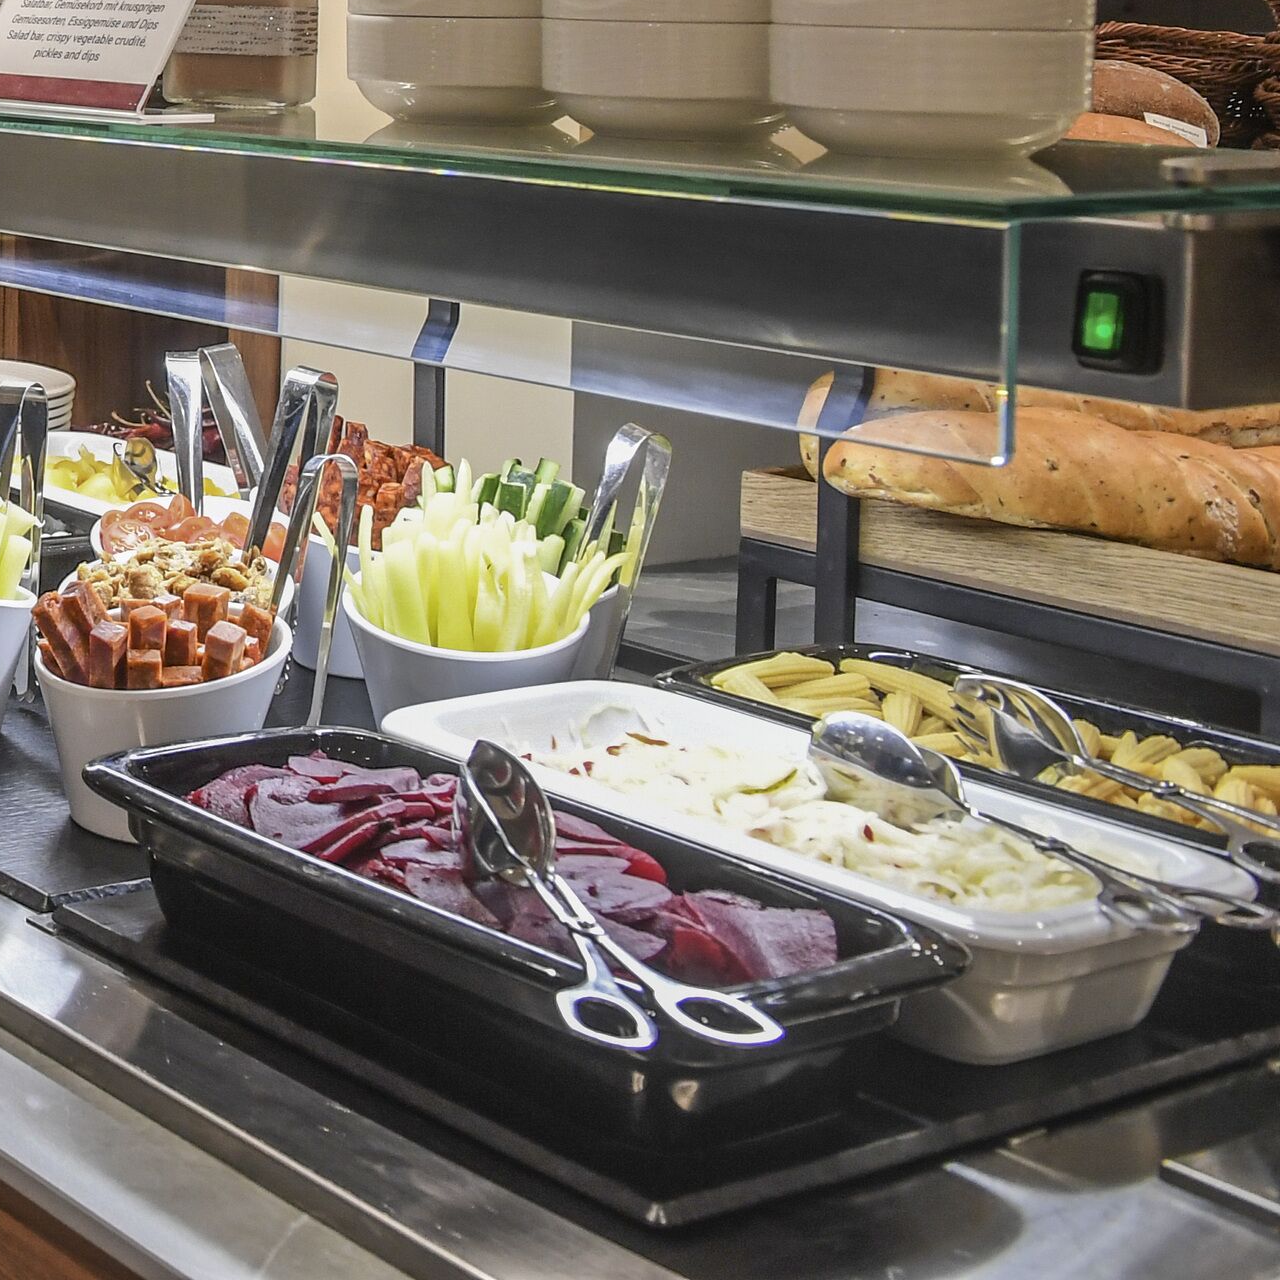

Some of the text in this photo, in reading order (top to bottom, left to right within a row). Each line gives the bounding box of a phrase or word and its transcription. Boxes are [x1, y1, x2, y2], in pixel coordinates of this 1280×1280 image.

[103, 1, 119, 11] mit
[118, 1, 165, 15] knusprigen
[67, 16, 121, 29] Essiggemüse
[121, 18, 140, 29] und
[139, 18, 159, 32] Dips
[6, 29, 30, 40] Salad
[29, 30, 45, 41] bar,
[46, 31, 72, 45] crispy
[72, 33, 114, 46] vegetable
[32, 48, 100, 63] pickles and dips
